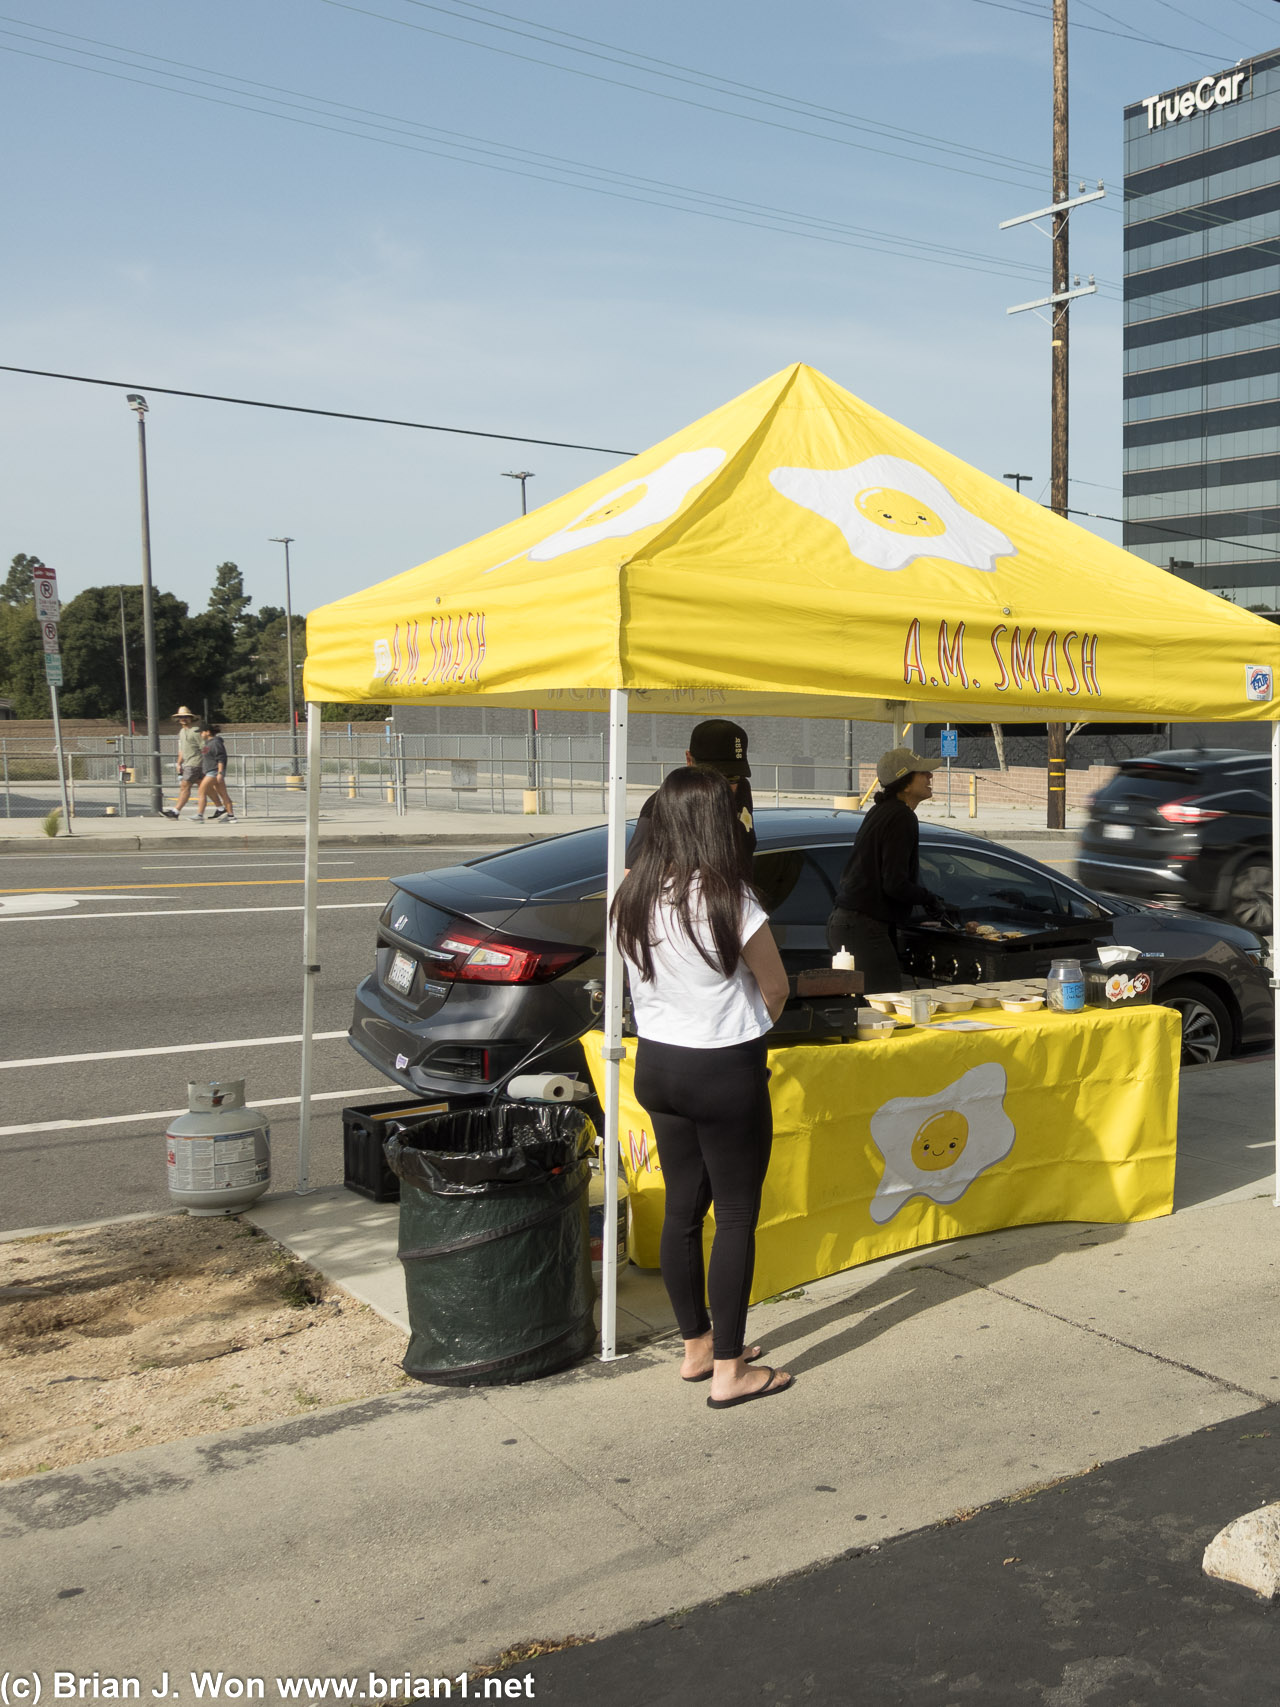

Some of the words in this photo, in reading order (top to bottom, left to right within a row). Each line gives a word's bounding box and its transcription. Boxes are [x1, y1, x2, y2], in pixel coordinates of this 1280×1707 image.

[1142, 72, 1245, 129] TrueCar
[422, 611, 487, 686] SMASH
[904, 617, 981, 689] A.M.
[991, 623, 1101, 697] SMASH
